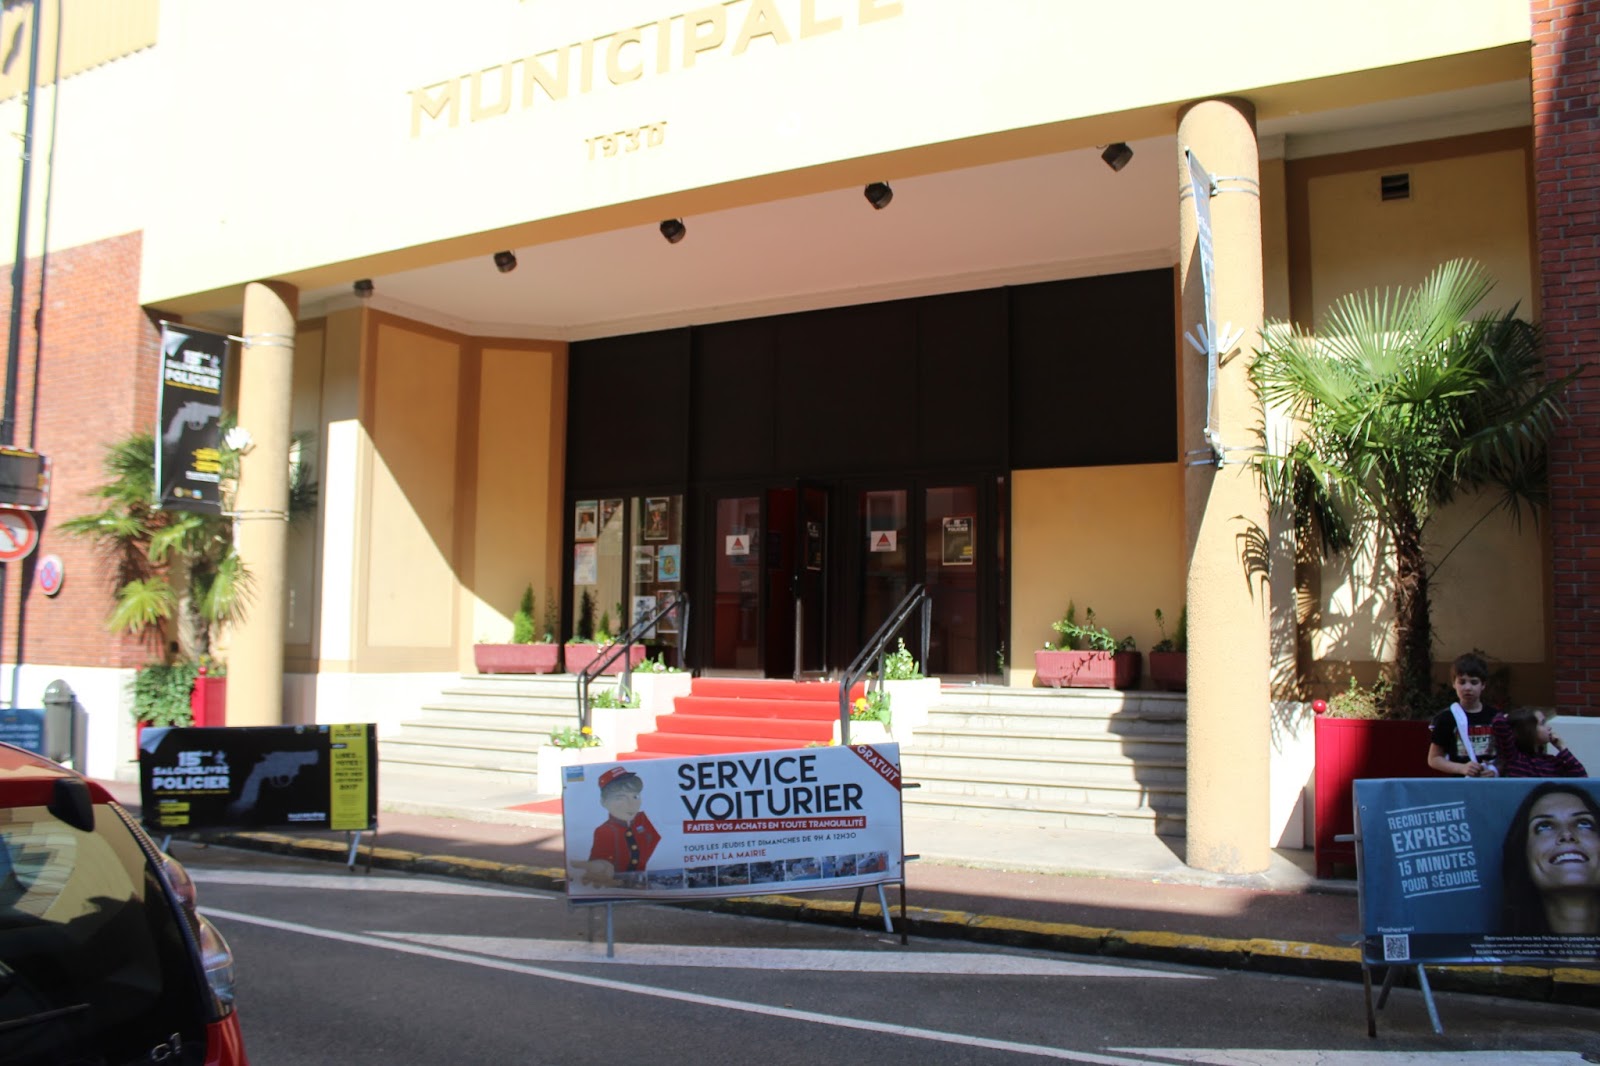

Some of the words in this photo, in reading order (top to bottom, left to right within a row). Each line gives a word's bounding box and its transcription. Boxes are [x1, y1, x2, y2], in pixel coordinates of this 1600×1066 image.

[584, 121, 667, 161] 1930
[678, 755, 818, 791] SERVICE
[857, 744, 900, 781] GRATUIT
[152, 776, 230, 790] POLICIER
[680, 783, 863, 821] VOITURIER
[687, 823, 715, 831] FAITES
[735, 822, 767, 830] ACHATS
[781, 820, 807, 829] TOUTE
[809, 817, 864, 828] TRANQUILLITÉ
[1387, 807, 1466, 830] RECRUTEMENT
[722, 841, 745, 849] JEUDIS
[758, 836, 800, 846] DIMANCHES
[833, 832, 857, 840] 12H30
[1391, 822, 1472, 853] EXPRESS
[684, 853, 719, 863] DEVANT
[736, 848, 767, 858] MAIRIE
[1398, 860, 1412, 877] 15
[1415, 851, 1476, 874] MINUTES
[1401, 876, 1428, 893] POUR
[1431, 869, 1479, 888] SÉDUIRE
